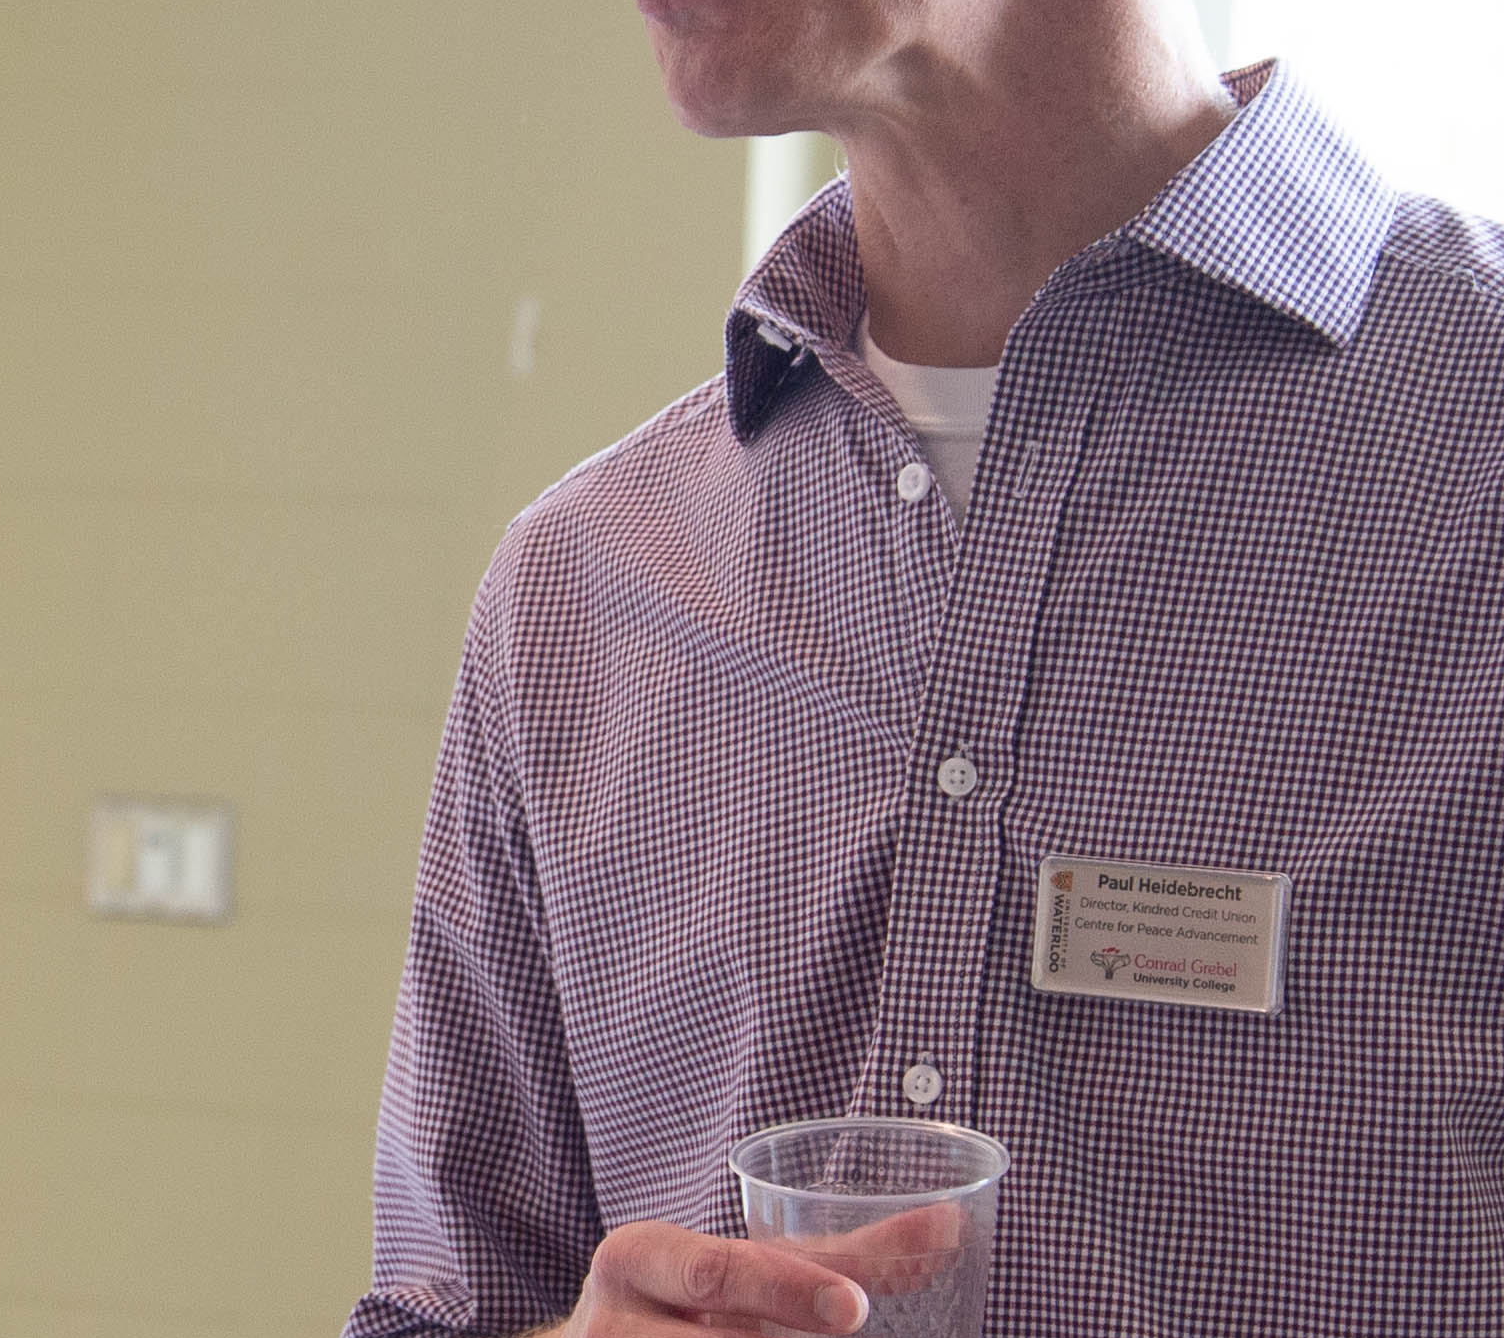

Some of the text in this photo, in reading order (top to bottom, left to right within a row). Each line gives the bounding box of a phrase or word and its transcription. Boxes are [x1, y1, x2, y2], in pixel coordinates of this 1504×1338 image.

[1098, 873, 1242, 902] Paul Heidebrecht
[1079, 896, 1257, 925] Director, Kindred Credit Union
[1048, 893, 1065, 974] WATERLOO
[1074, 916, 1259, 946] Centre for Peace Advancement
[1134, 952, 1238, 978] Conrad Grebel
[1133, 972, 1237, 994] University College
